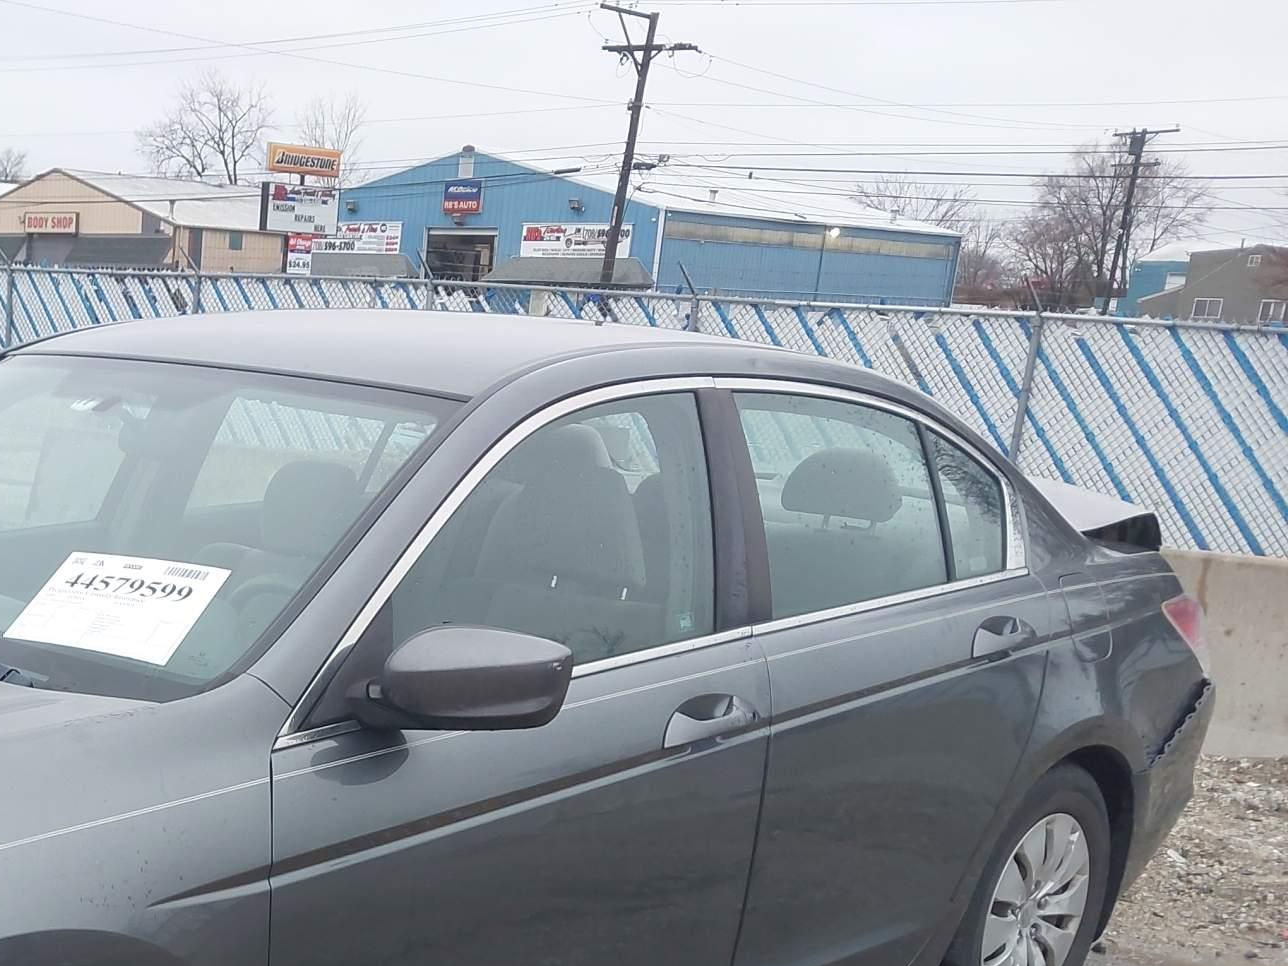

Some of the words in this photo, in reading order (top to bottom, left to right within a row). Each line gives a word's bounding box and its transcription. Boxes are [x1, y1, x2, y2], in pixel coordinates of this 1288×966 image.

[275, 151, 337, 171] BRIDGESTONE
[458, 200, 478, 209] AUTO
[27, 216, 48, 228] BODY
[51, 216, 74, 229] SHOP
[64, 571, 194, 602] 44579599
